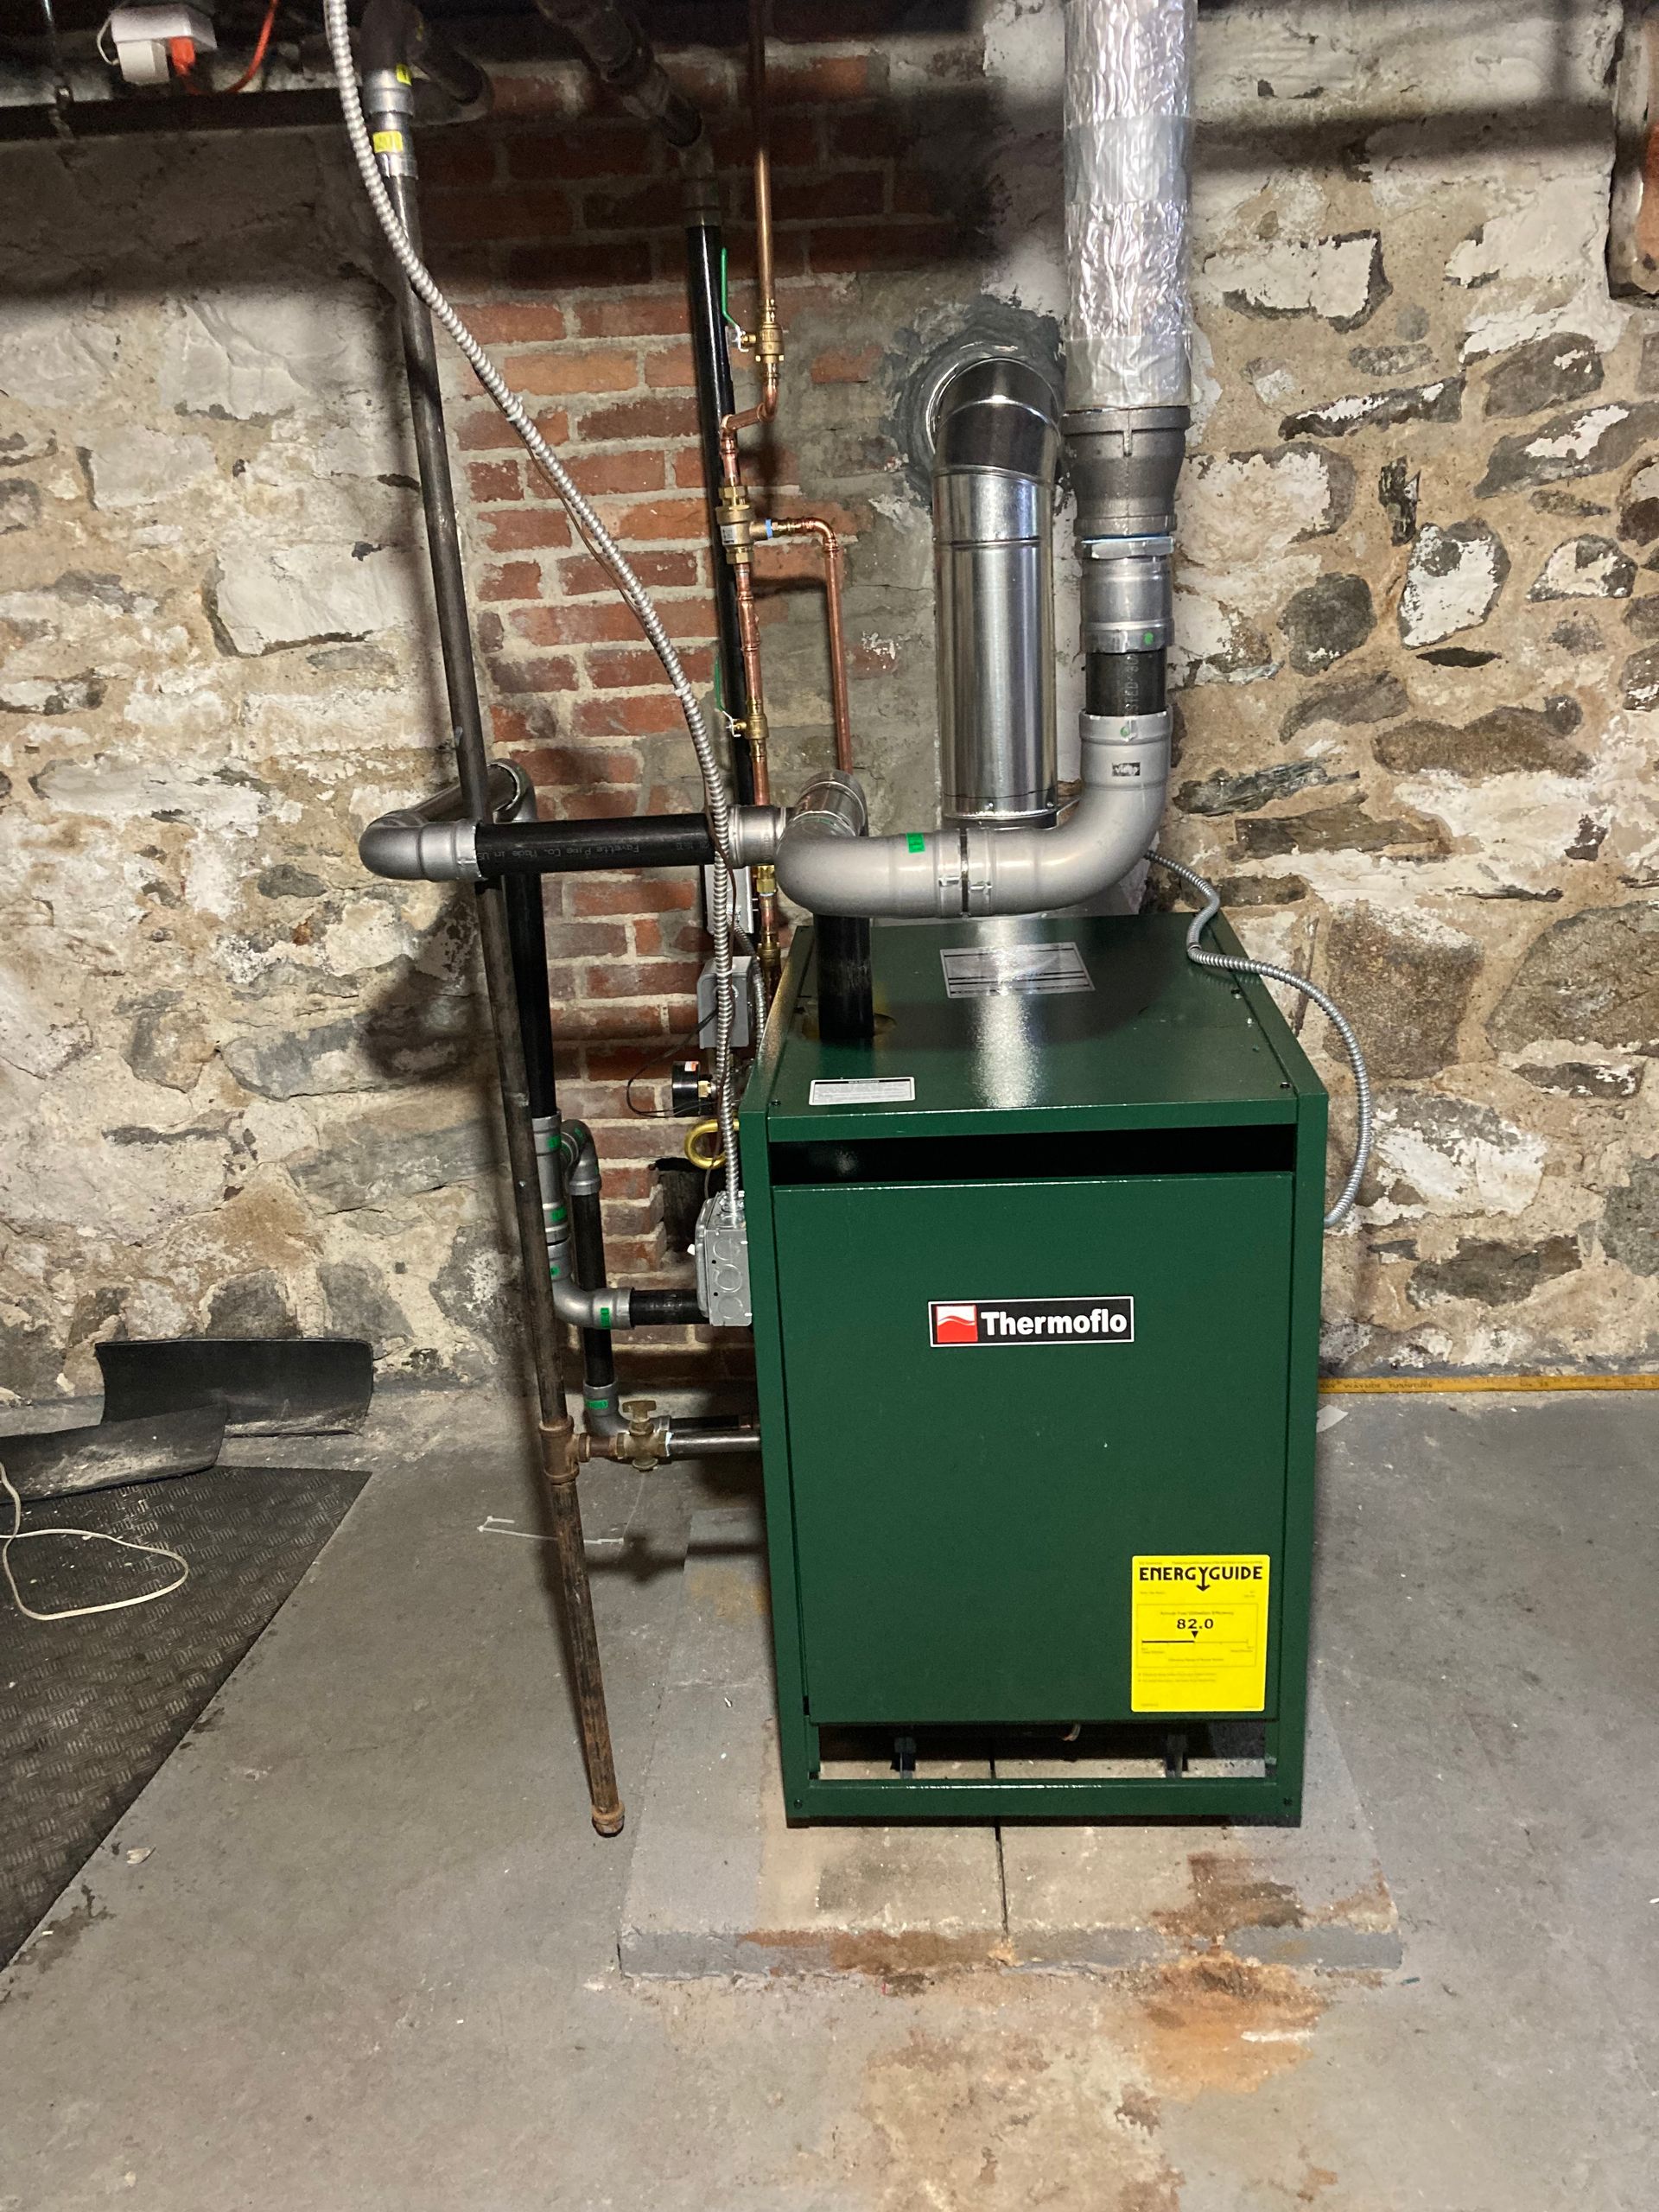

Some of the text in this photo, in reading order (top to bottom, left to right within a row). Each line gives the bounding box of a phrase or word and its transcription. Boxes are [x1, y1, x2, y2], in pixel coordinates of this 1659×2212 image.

[981, 1308, 1128, 1336] Thermoflo
[1139, 1566, 1263, 1587] ENERGYGUIDE
[1177, 1618, 1214, 1630] 82.0
